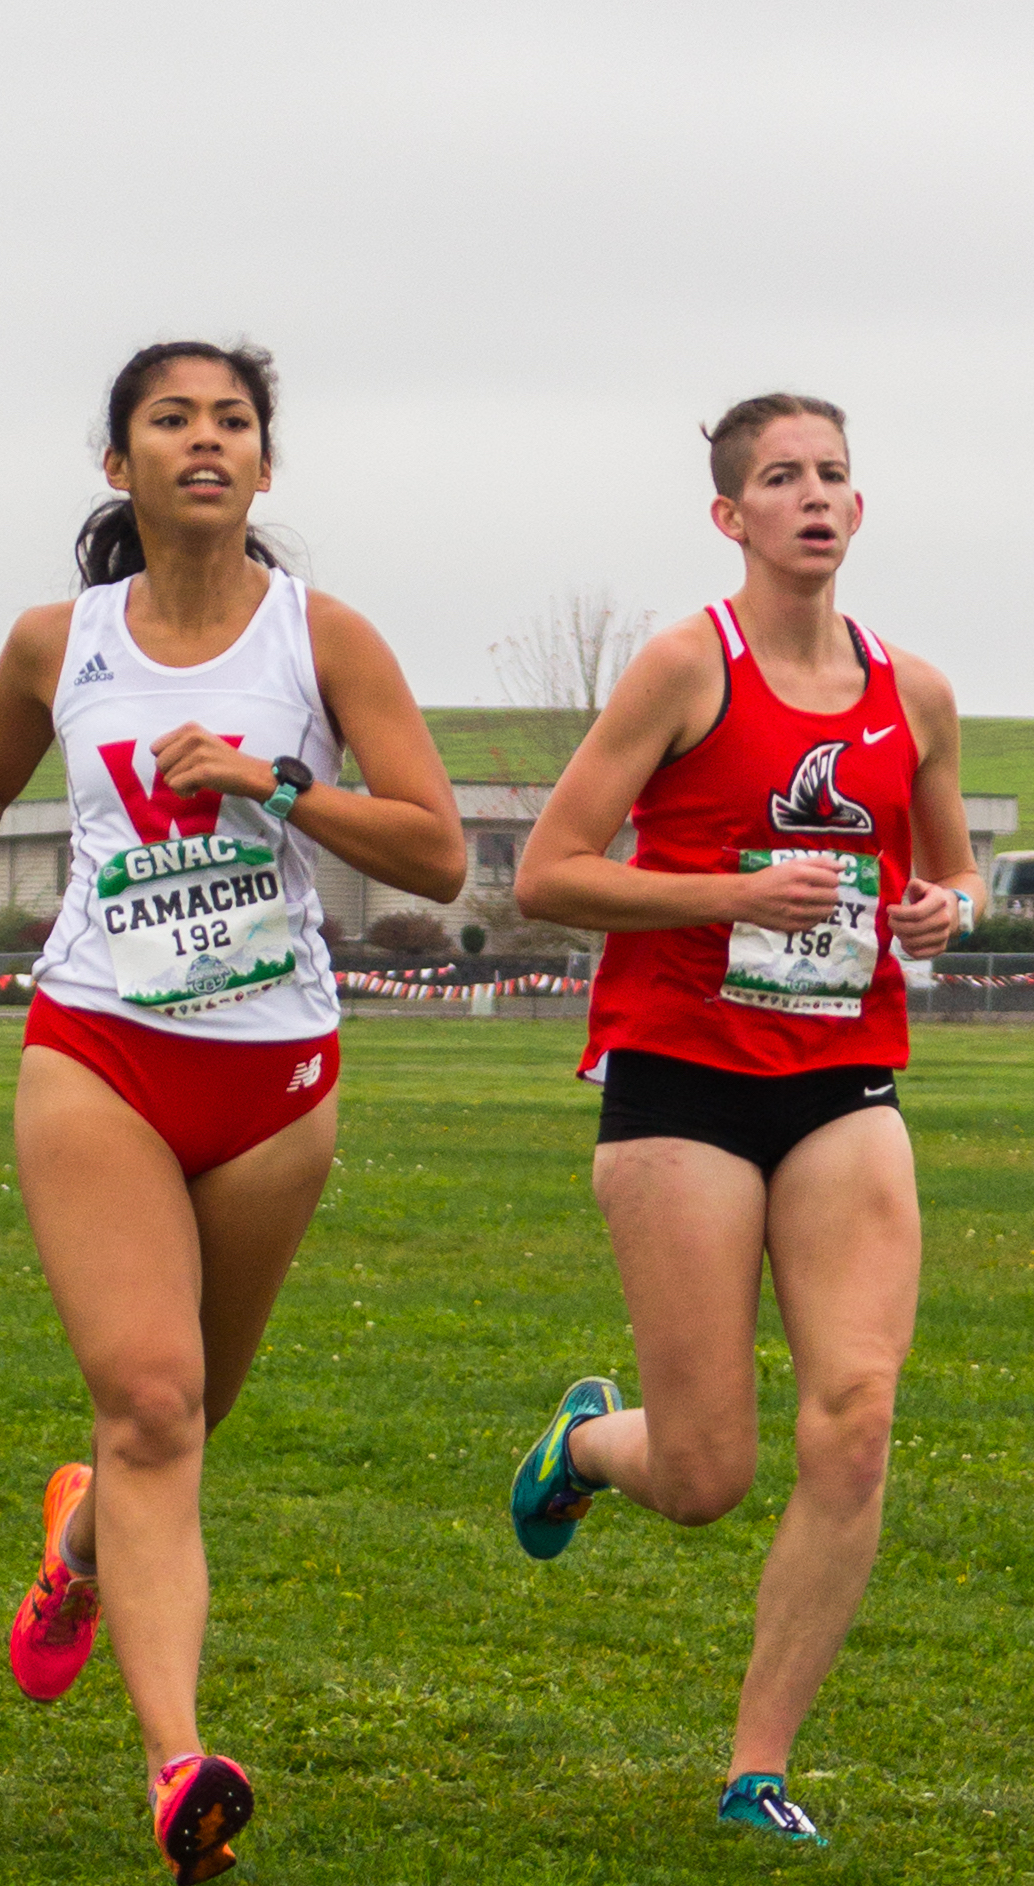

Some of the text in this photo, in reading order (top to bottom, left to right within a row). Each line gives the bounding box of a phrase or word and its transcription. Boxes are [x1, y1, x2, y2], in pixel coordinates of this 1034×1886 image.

[74, 671, 114, 686] adidas
[124, 835, 238, 882] GNAC
[104, 870, 281, 935] CAMACHO
[171, 919, 232, 957] 192
[783, 929, 833, 958] 158
